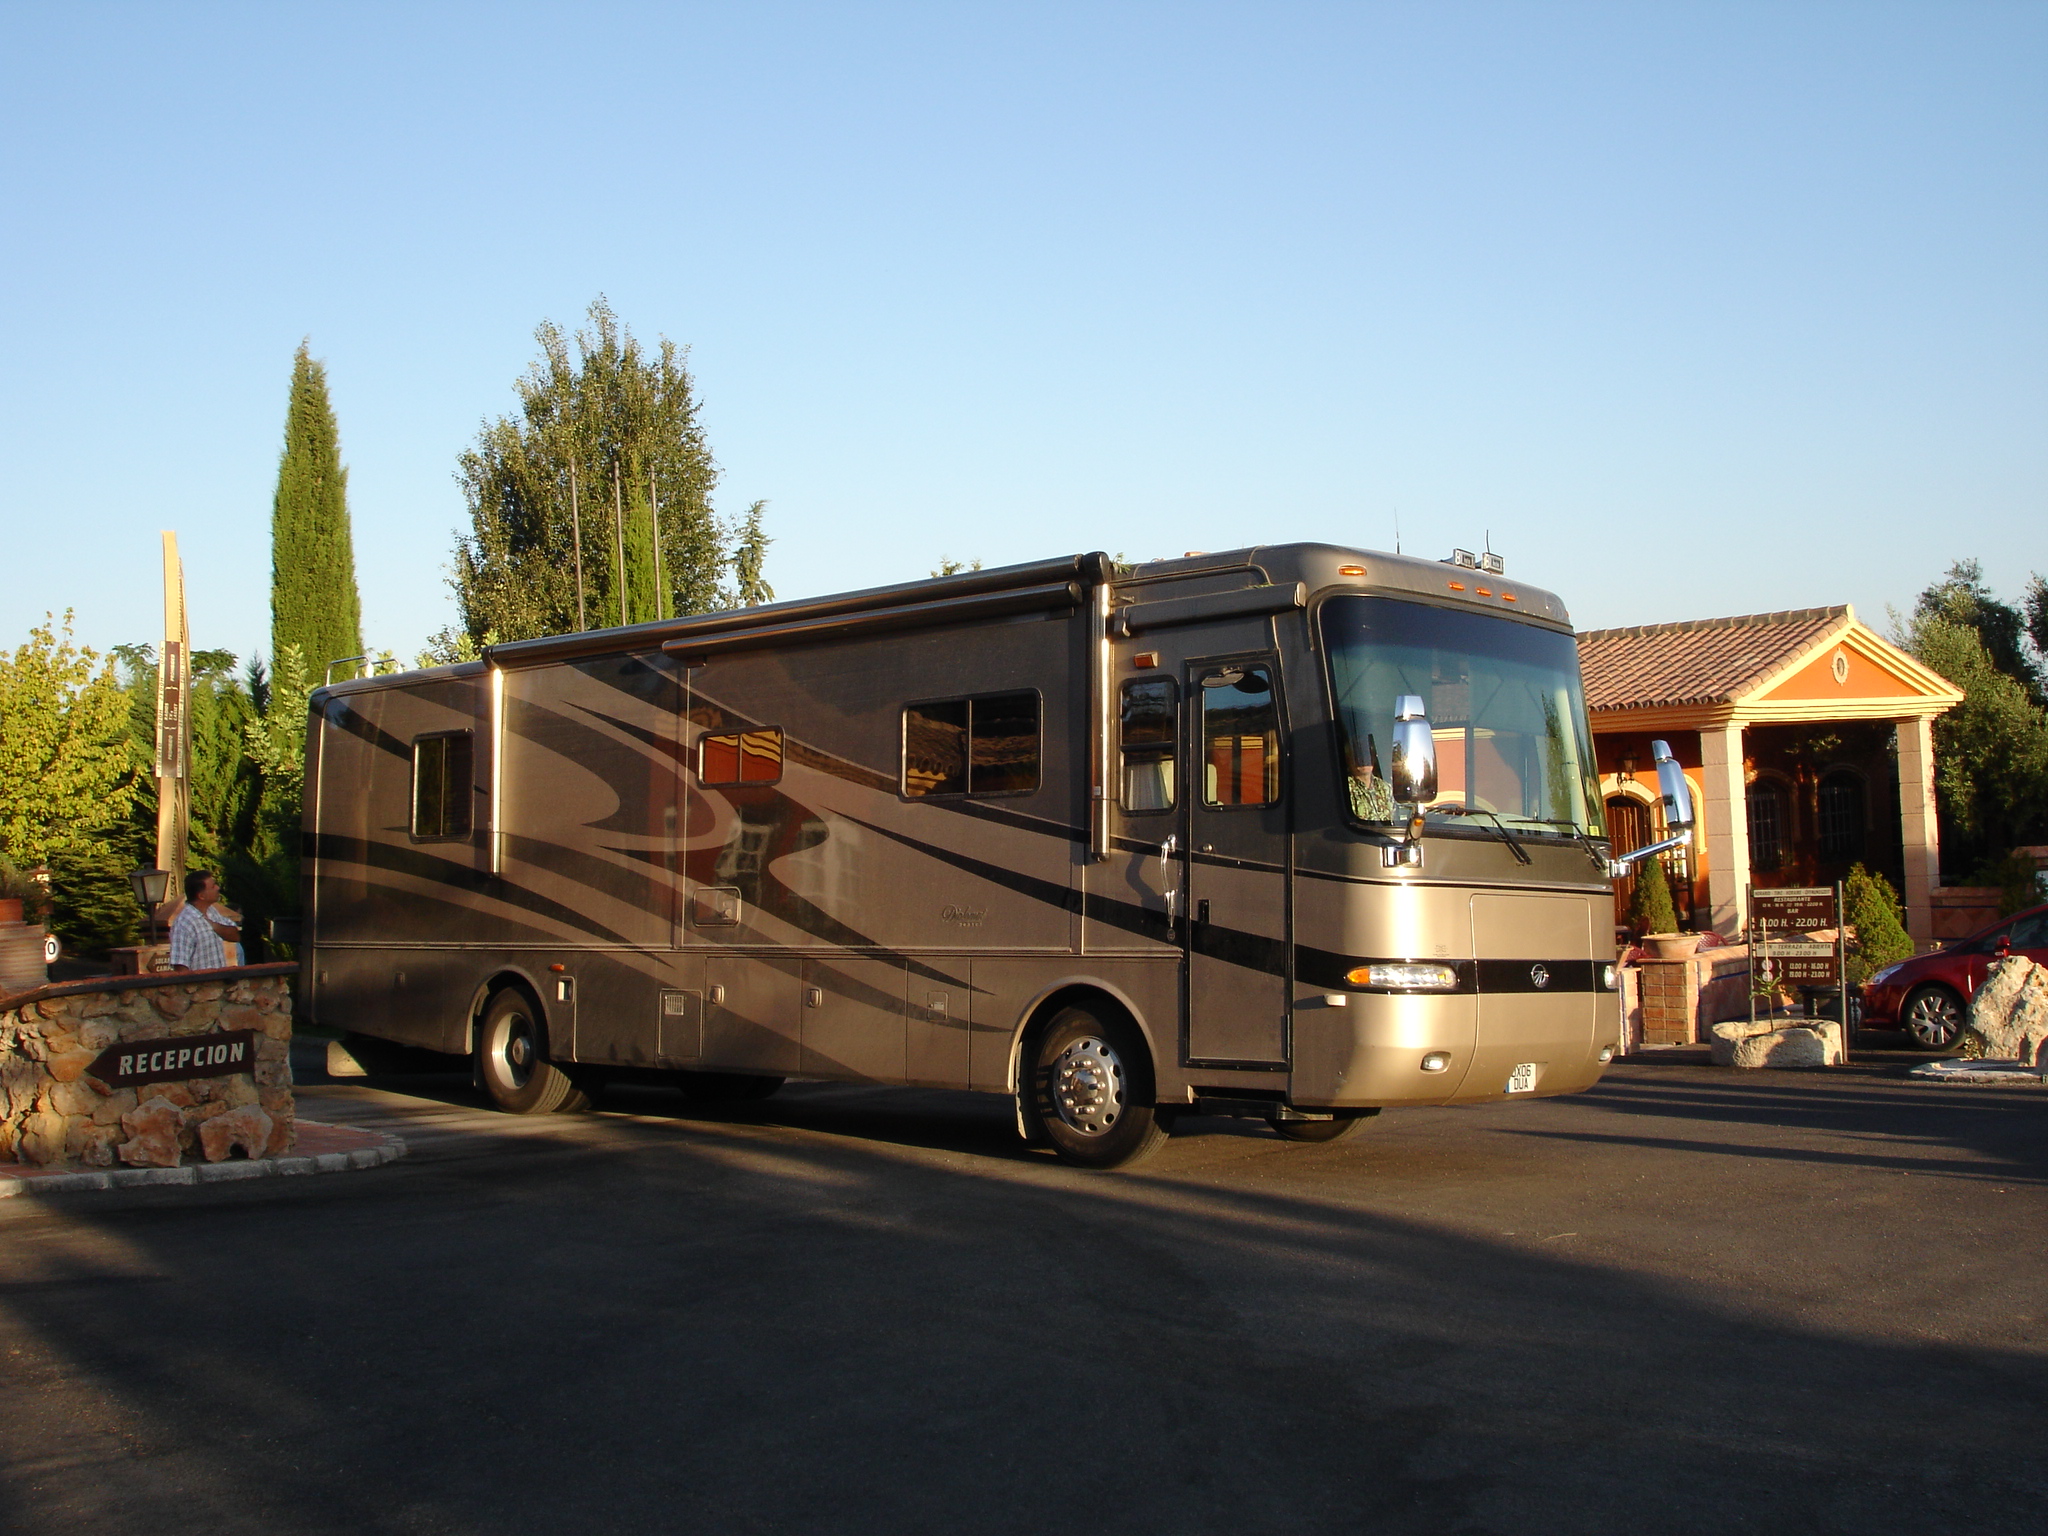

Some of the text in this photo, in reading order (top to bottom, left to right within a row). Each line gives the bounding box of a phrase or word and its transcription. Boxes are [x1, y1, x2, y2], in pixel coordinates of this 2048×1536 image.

[1760, 918, 1779, 927] 1.00
[1796, 918, 1818, 927] 22.00
[48, 942, 56, 954] 0
[119, 1042, 244, 1076] RECEPCION
[1514, 1078, 1529, 1090] DUA
